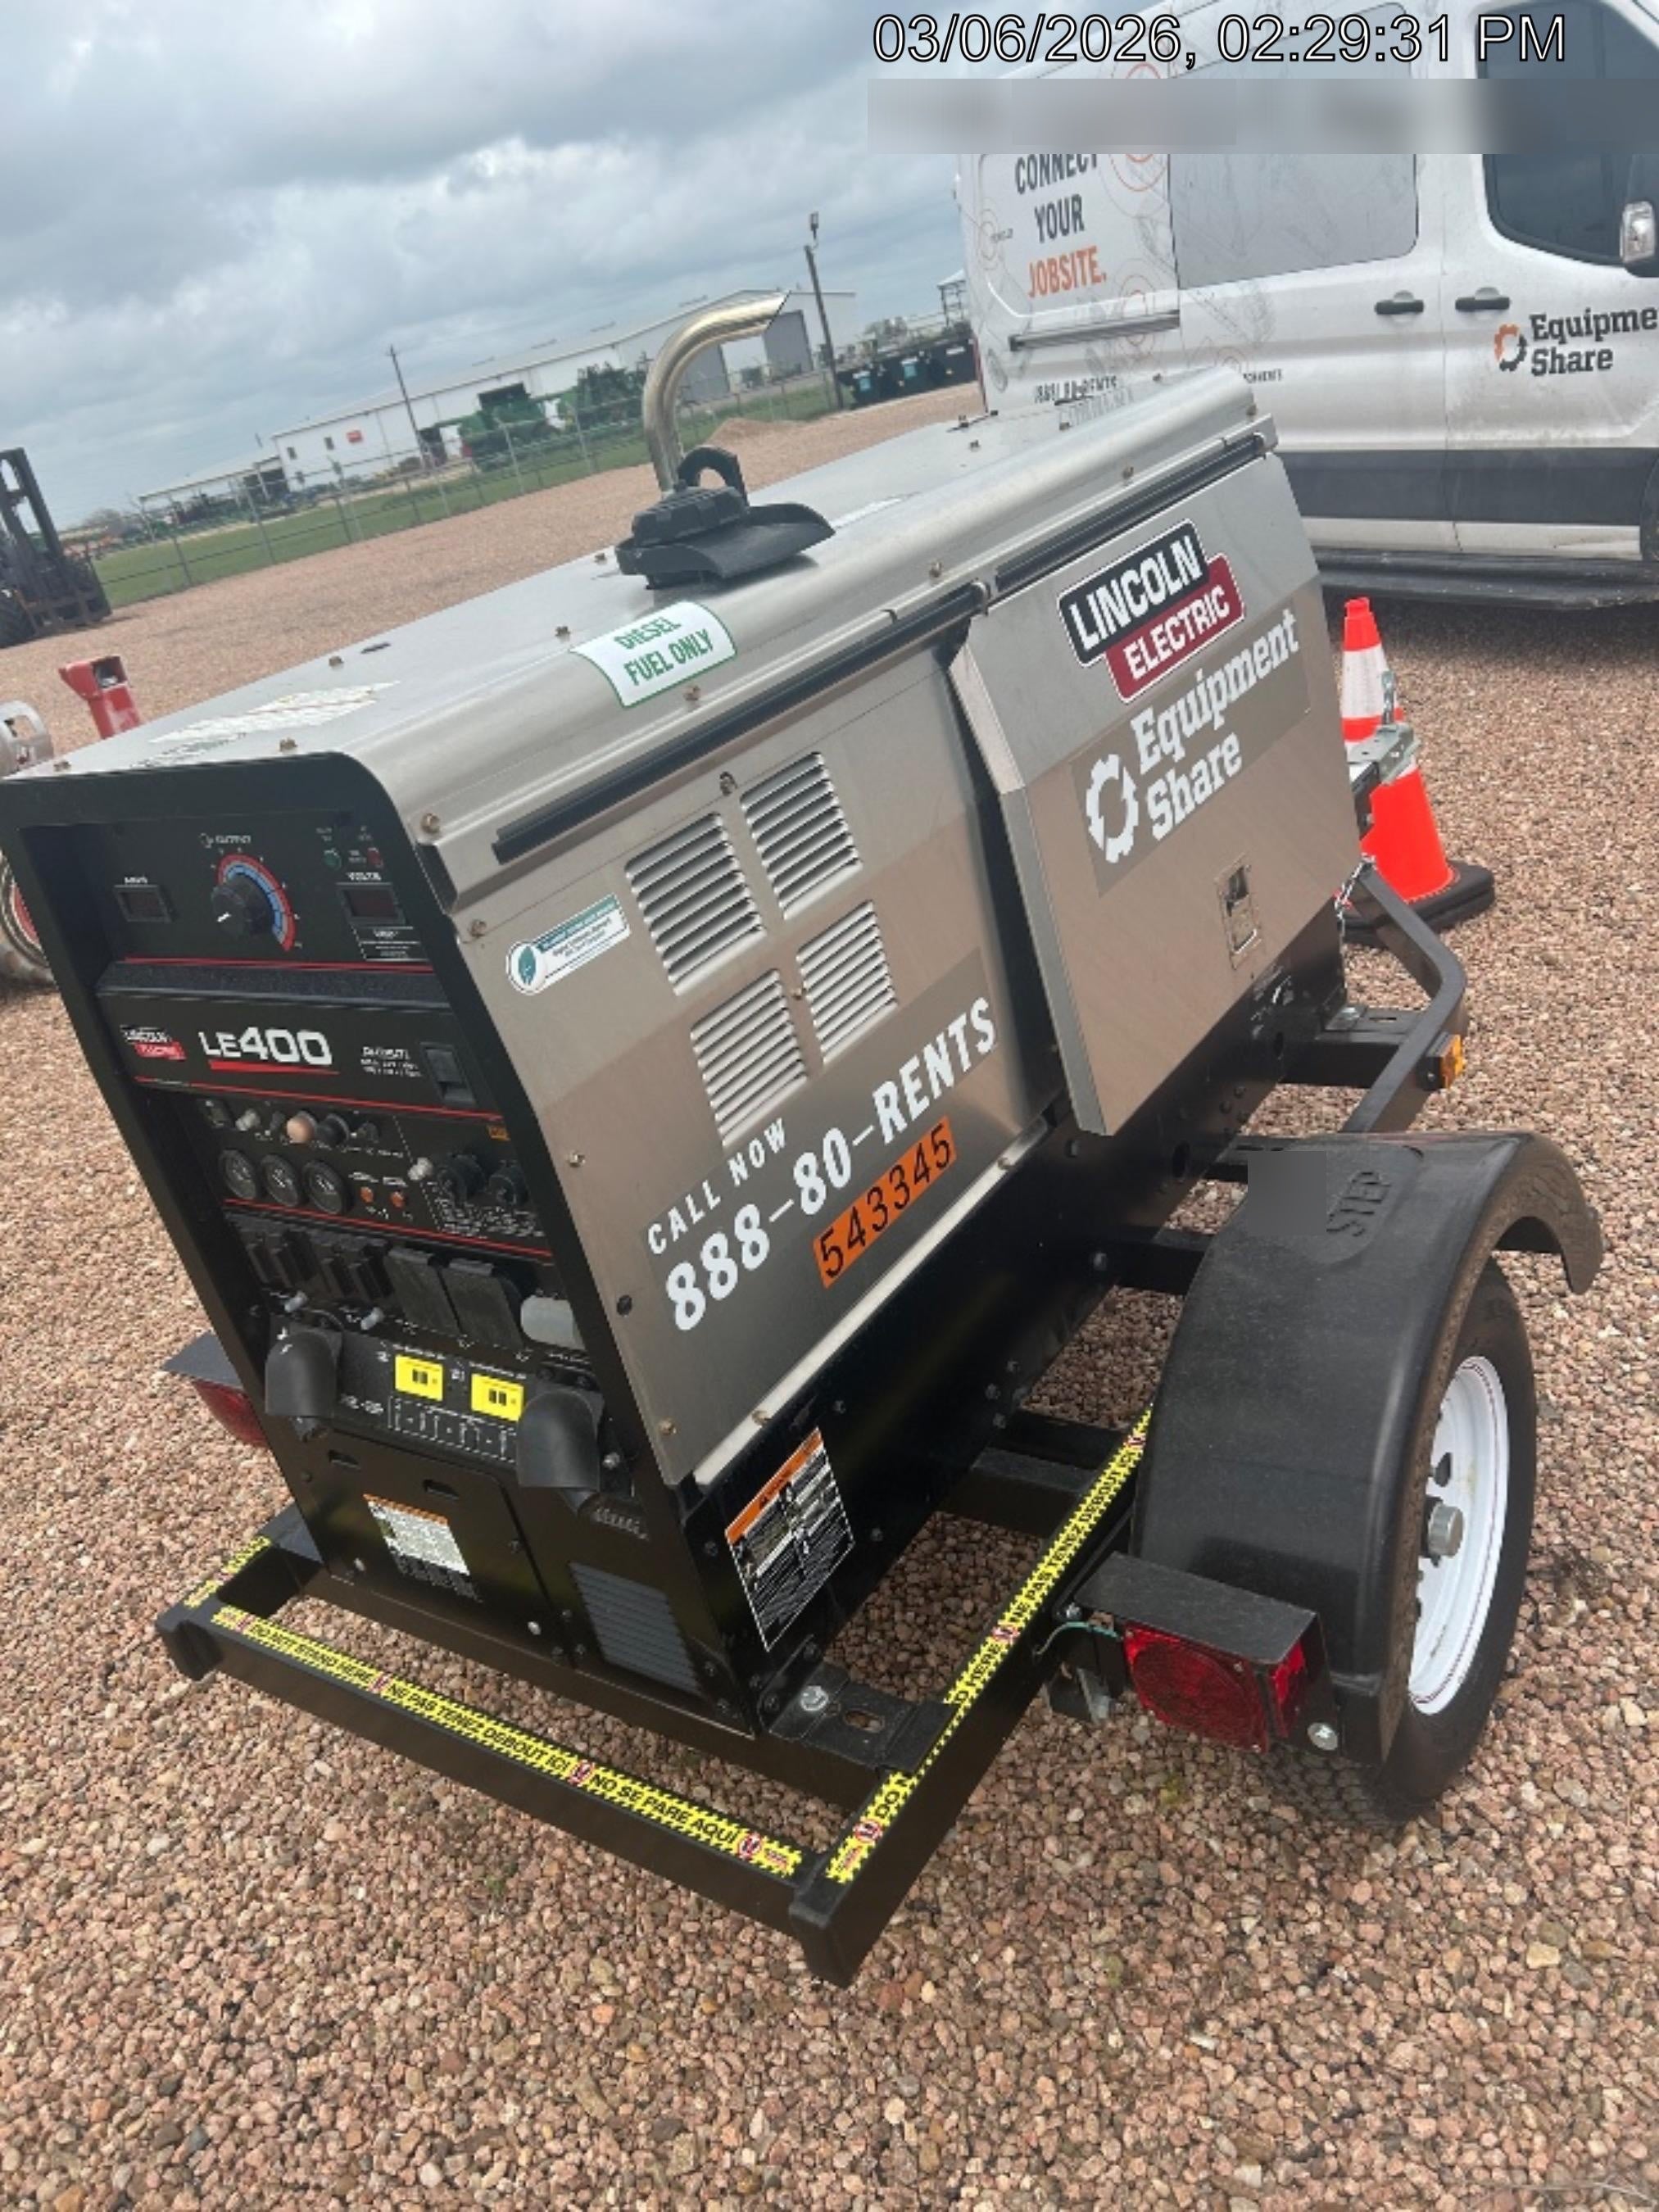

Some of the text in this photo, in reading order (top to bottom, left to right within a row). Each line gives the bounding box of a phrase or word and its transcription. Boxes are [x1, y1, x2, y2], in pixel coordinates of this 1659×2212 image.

[1034, 193, 1085, 244] YOUR
[1028, 246, 1107, 298] JOBSITE.
[1530, 347, 1613, 377] Share
[614, 616, 682, 650] DIESEL
[1069, 535, 1203, 651] LINCOLN
[1122, 584, 1231, 679] ELECTRIC
[623, 628, 714, 687] FUEL ONLY
[1130, 608, 1300, 775] Equipment
[1146, 732, 1243, 841] Share
[197, 1026, 333, 1066] LE400
[647, 1117, 786, 1255] CALL NOW
[665, 996, 997, 1331] 888-80-RENTS
[819, 1122, 953, 1279] 543345
[590, 1774, 738, 1844] NO SE PARE AQUI
